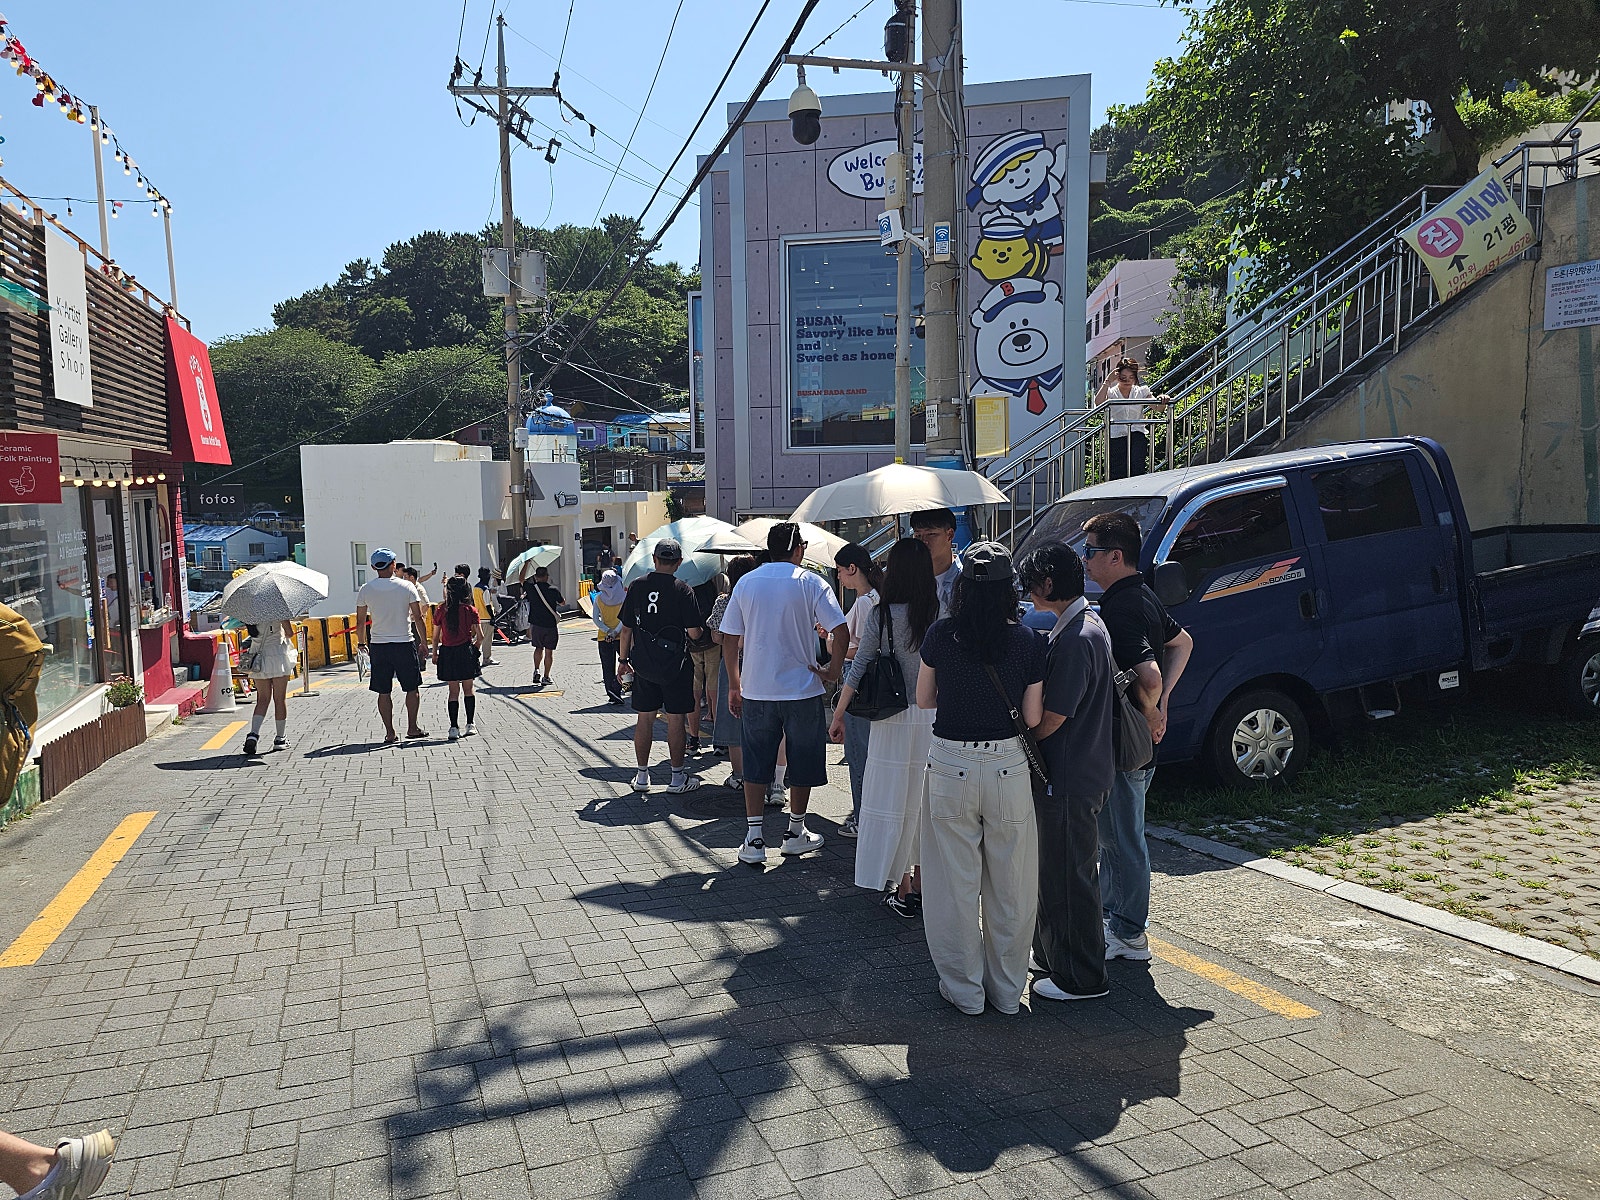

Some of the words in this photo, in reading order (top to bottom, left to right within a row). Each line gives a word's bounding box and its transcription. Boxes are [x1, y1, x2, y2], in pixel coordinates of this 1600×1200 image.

[1456, 177, 1508, 227] 매매
[1420, 219, 1459, 254] 집
[1483, 213, 1517, 251] 21평
[1000, 281, 1015, 297] B
[56, 295, 81, 326] K-Artist
[796, 315, 846, 327] BUSAN,
[58, 324, 83, 355] Gallery
[796, 328, 844, 340] Savory
[848, 327, 873, 337] like
[796, 341, 821, 351] and
[796, 353, 839, 363] Sweet
[842, 353, 857, 362] as
[860, 350, 896, 362] hone
[60, 350, 85, 380] Shop
[18, 456, 52, 464] Painting
[199, 494, 236, 504] fofos
[1269, 572, 1297, 584] BONGO
